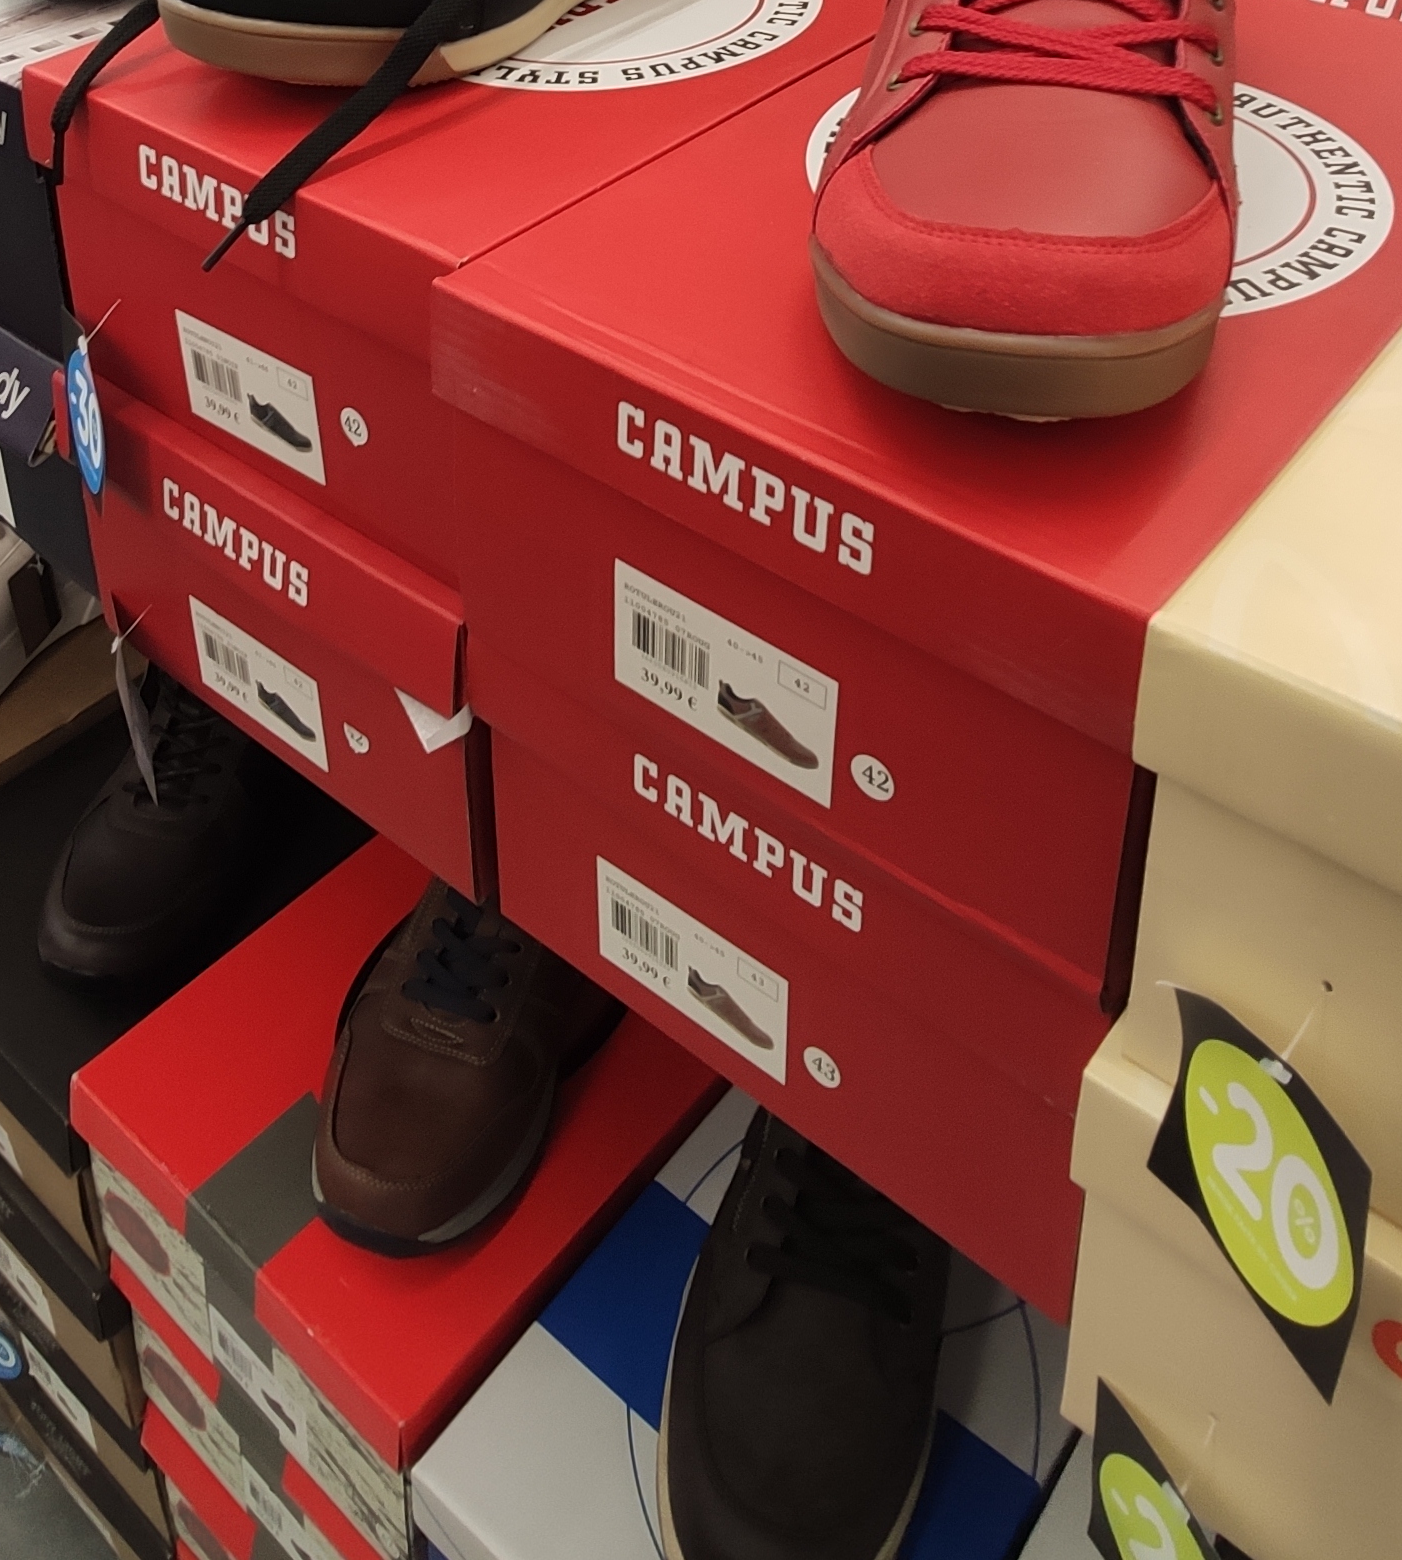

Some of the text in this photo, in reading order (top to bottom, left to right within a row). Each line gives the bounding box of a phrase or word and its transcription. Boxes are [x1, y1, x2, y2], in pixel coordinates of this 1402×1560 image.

[621, 30, 780, 82] CAMPUS
[1235, 92, 1377, 221] AUTHENTIC
[343, 414, 363, 438] 42
[617, 400, 875, 576] CAMPUS
[163, 476, 310, 608] CAMPUS
[640, 666, 699, 712] 39,99 €
[793, 677, 811, 694] 42
[861, 765, 890, 793] 42
[633, 753, 864, 933] CAMPUS
[621, 947, 673, 990] 39,99 €
[750, 971, 767, 988] 43
[810, 1056, 836, 1083] 43
